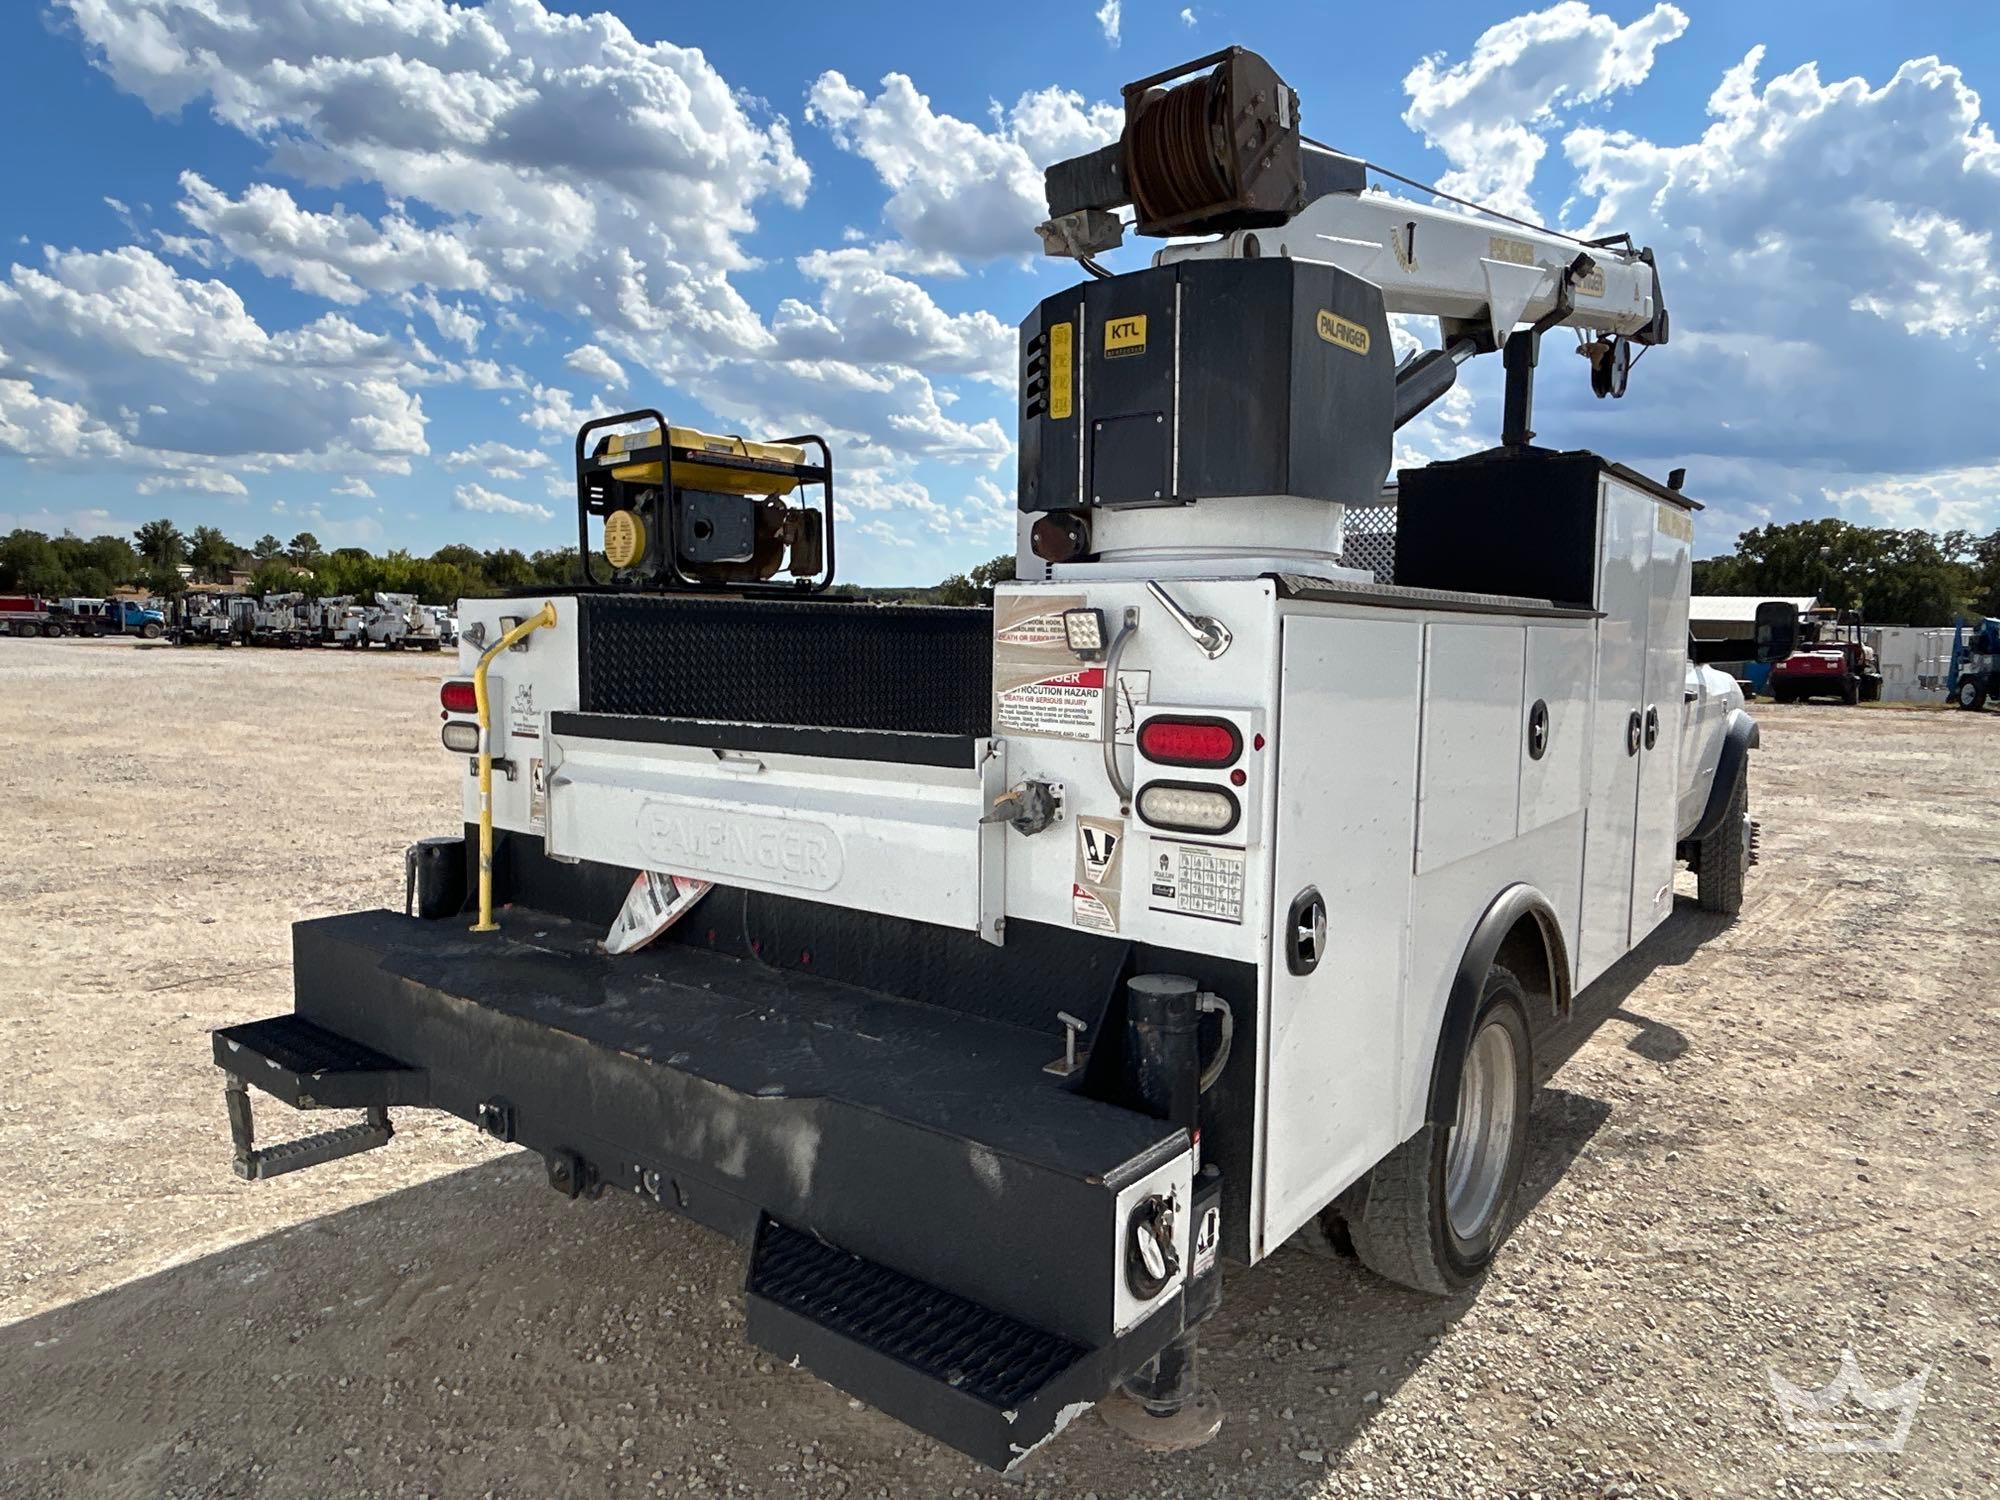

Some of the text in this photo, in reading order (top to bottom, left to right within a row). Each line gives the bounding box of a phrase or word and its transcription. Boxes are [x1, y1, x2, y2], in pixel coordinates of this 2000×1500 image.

[1112, 322, 1139, 339] KTL
[1320, 315, 1367, 349] PALFINGER
[1035, 696, 1063, 704] SERIOUS
[1064, 698, 1088, 706] INJURY
[1064, 688, 1099, 698] HAZARD
[651, 812, 828, 878] PALFINGER
